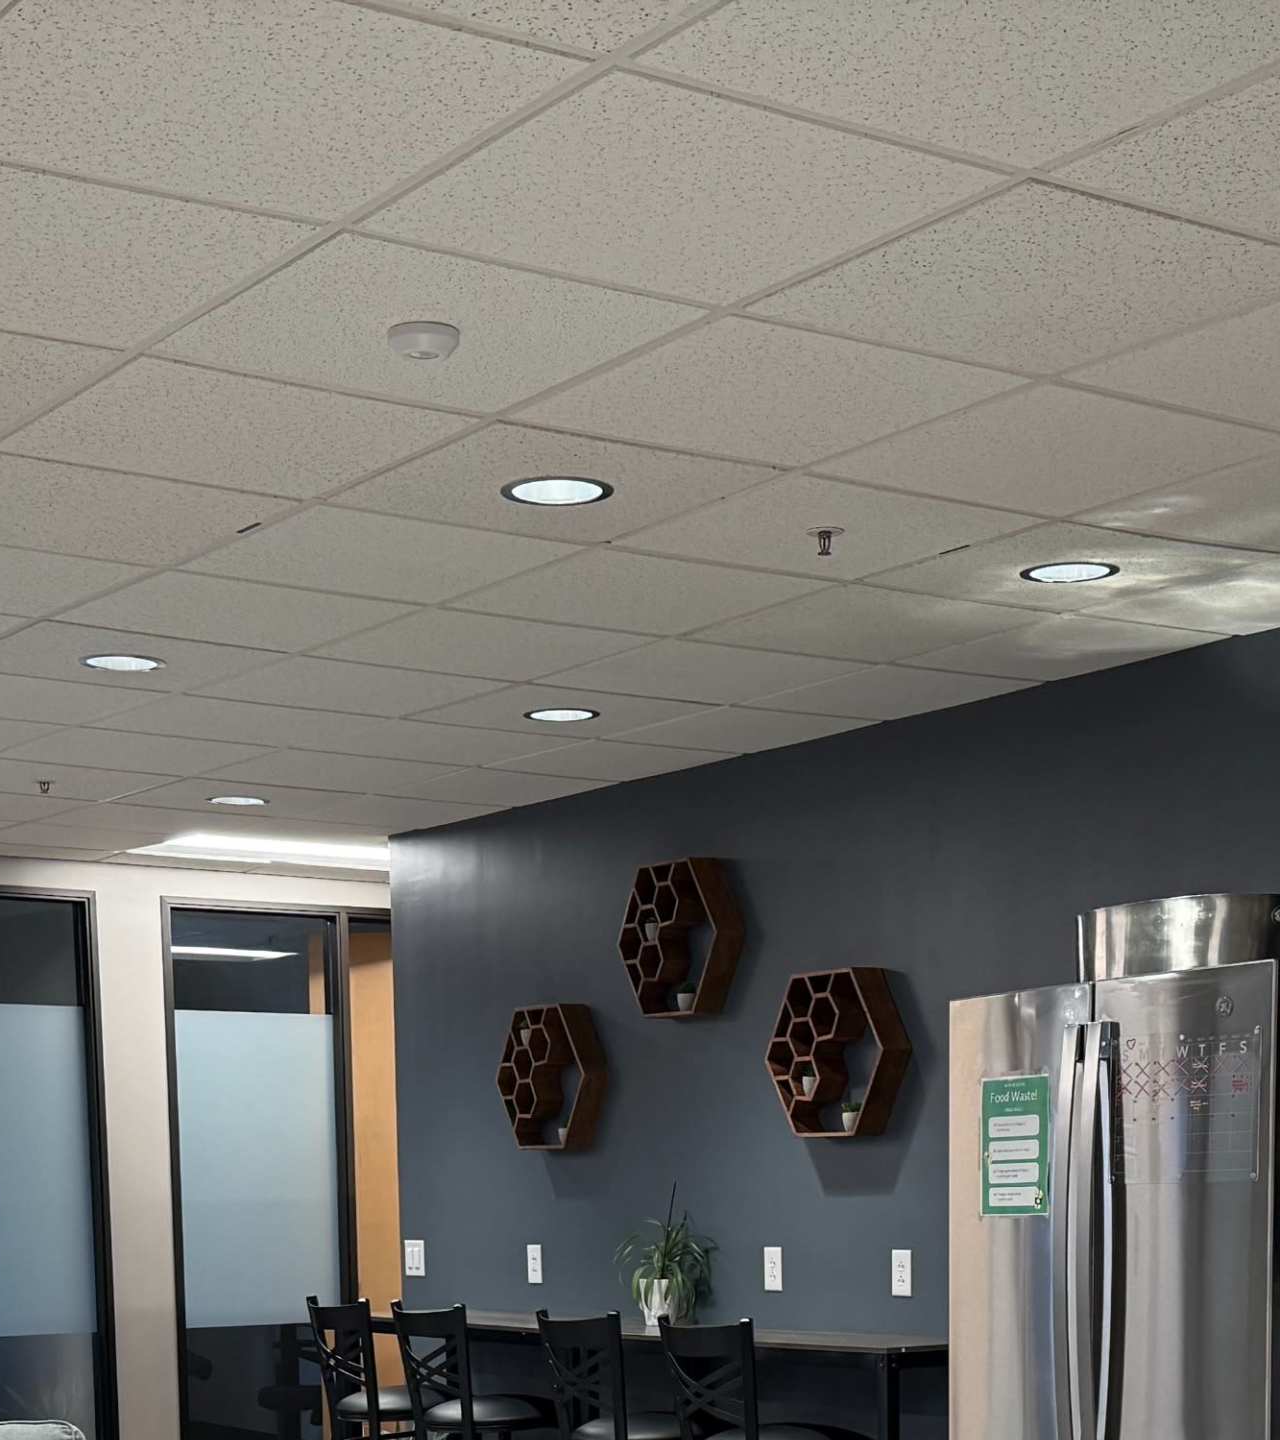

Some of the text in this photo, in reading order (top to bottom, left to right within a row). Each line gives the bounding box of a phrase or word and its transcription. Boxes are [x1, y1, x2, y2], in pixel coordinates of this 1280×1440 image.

[1176, 1045, 1189, 1058] W
[1198, 1043, 1206, 1056] T
[1220, 1042, 1227, 1055] F
[1239, 1040, 1247, 1053] S
[990, 1091, 1010, 1103] Food
